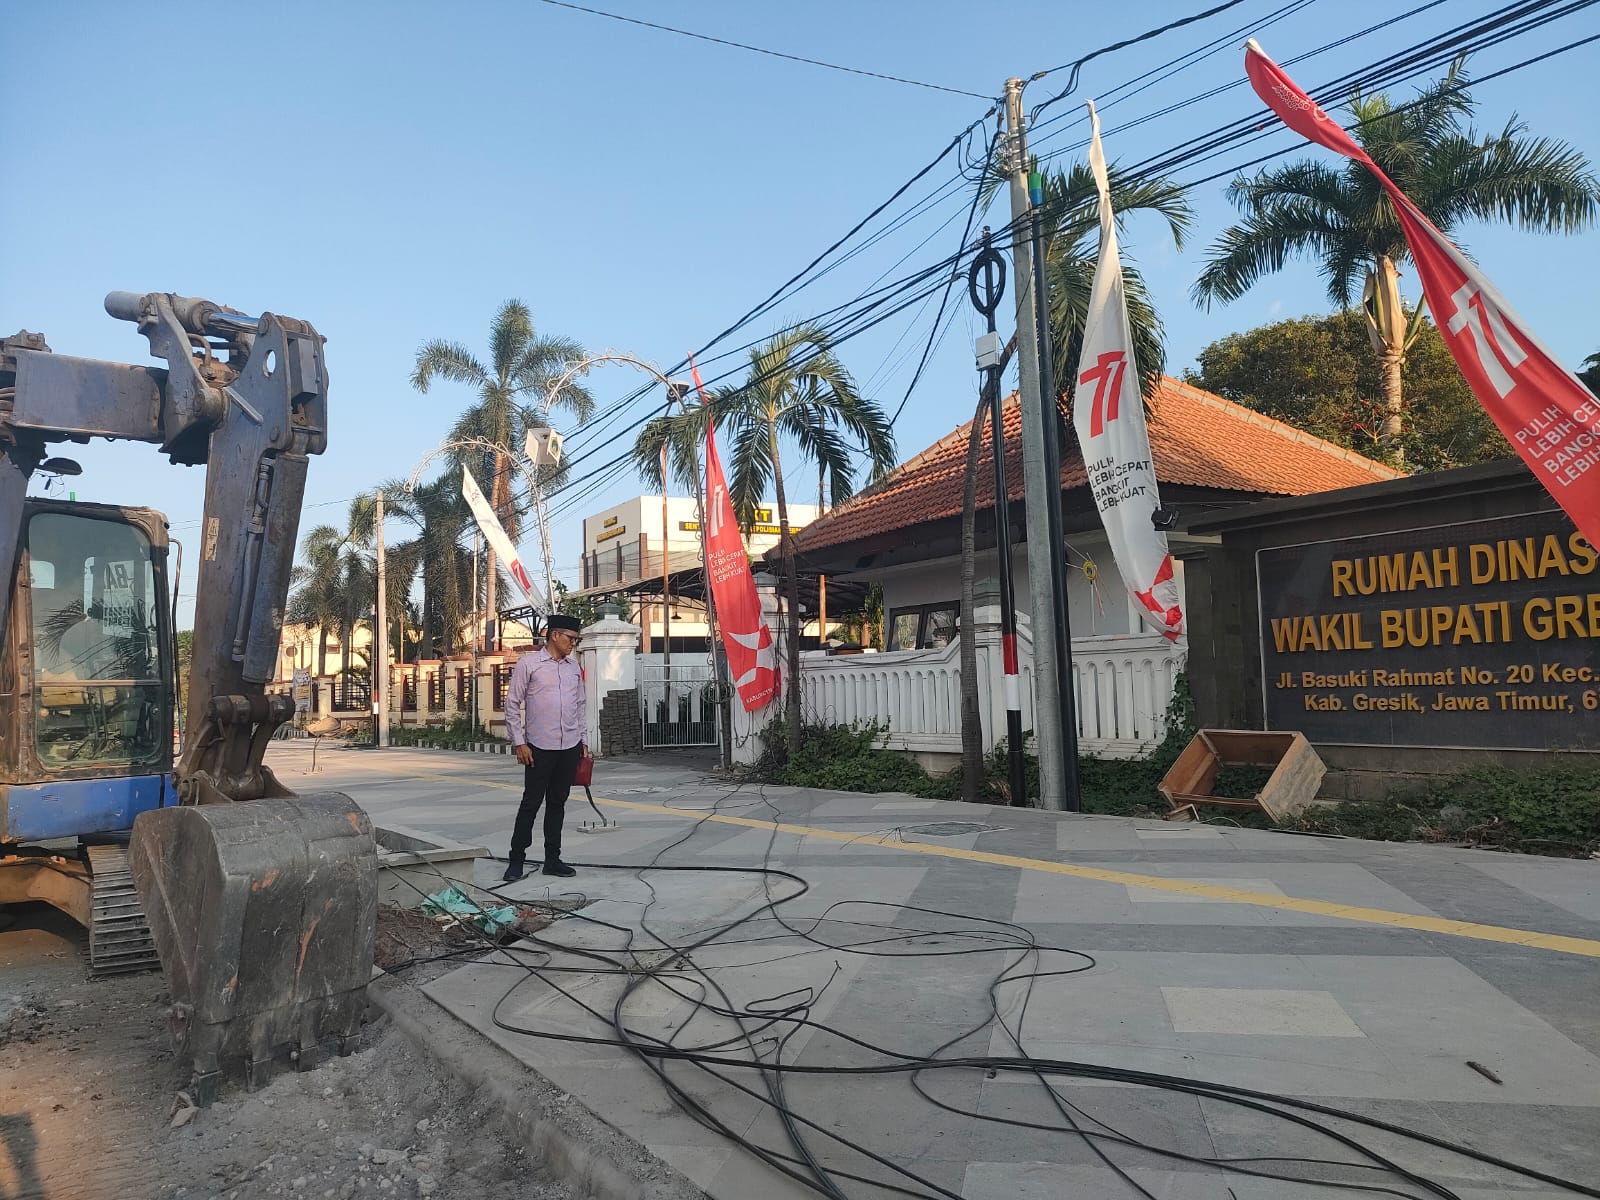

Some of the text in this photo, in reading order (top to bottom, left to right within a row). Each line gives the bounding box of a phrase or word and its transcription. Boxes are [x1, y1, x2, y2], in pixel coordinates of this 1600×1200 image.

[1080, 350, 1127, 438] 77
[1514, 403, 1564, 445] PULIH
[1528, 398, 1600, 459] LEBIH CE
[1115, 460, 1150, 477] CEPAT
[1331, 531, 1597, 598] RUMAH DINAS
[1271, 592, 1600, 653] WAKIL BUPATI GRE
[1302, 669, 1369, 689] Basuki
[1372, 667, 1456, 688] Rahmat
[1460, 664, 1500, 685] No.
[1506, 664, 1534, 684] 20
[1542, 662, 1600, 683] Kec.
[1304, 693, 1348, 712] Kab.
[1352, 692, 1426, 715] Gresik,
[1431, 692, 1490, 713] Jawa
[1495, 690, 1574, 715] Timur,
